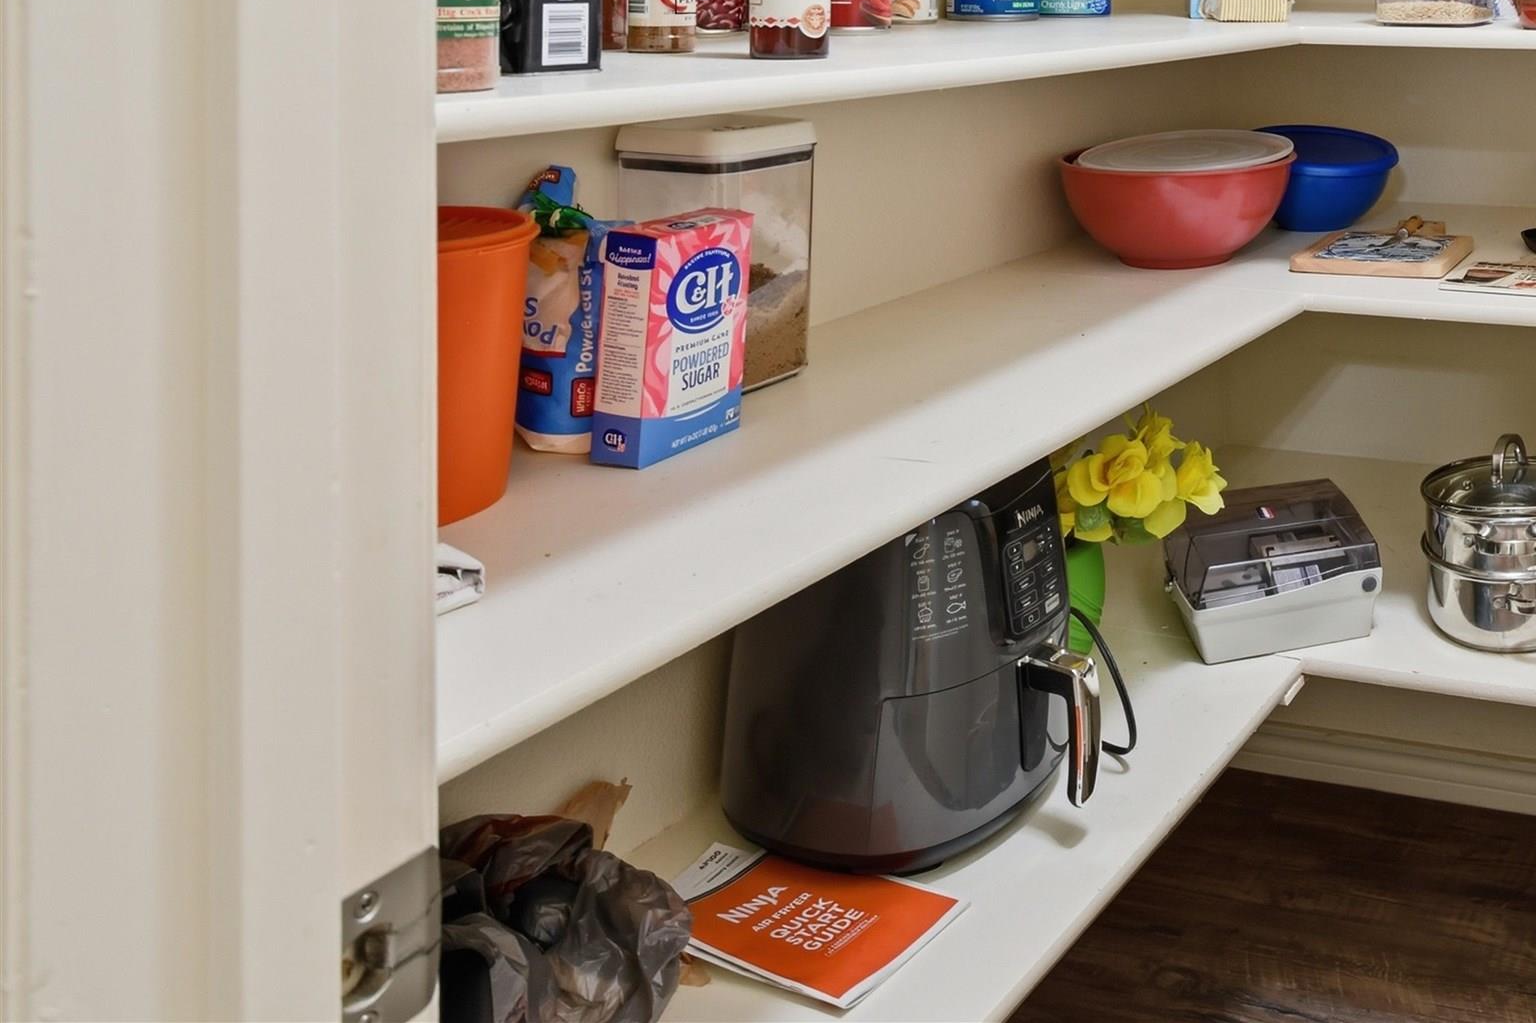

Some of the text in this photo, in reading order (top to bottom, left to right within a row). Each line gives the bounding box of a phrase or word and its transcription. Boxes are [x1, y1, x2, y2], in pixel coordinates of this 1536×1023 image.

[675, 260, 735, 315] C&H
[672, 341, 730, 376] POWDERED
[675, 329, 729, 353] PREMIUM CANE
[681, 362, 721, 391] SUGAR
[575, 382, 586, 413] WinCo
[1014, 504, 1044, 529] NINJA
[716, 885, 790, 924] NINJA
[752, 892, 813, 933] AIR FRYER
[769, 897, 834, 940] QUICK
[785, 902, 845, 945] START
[802, 907, 865, 952] GUIDE
